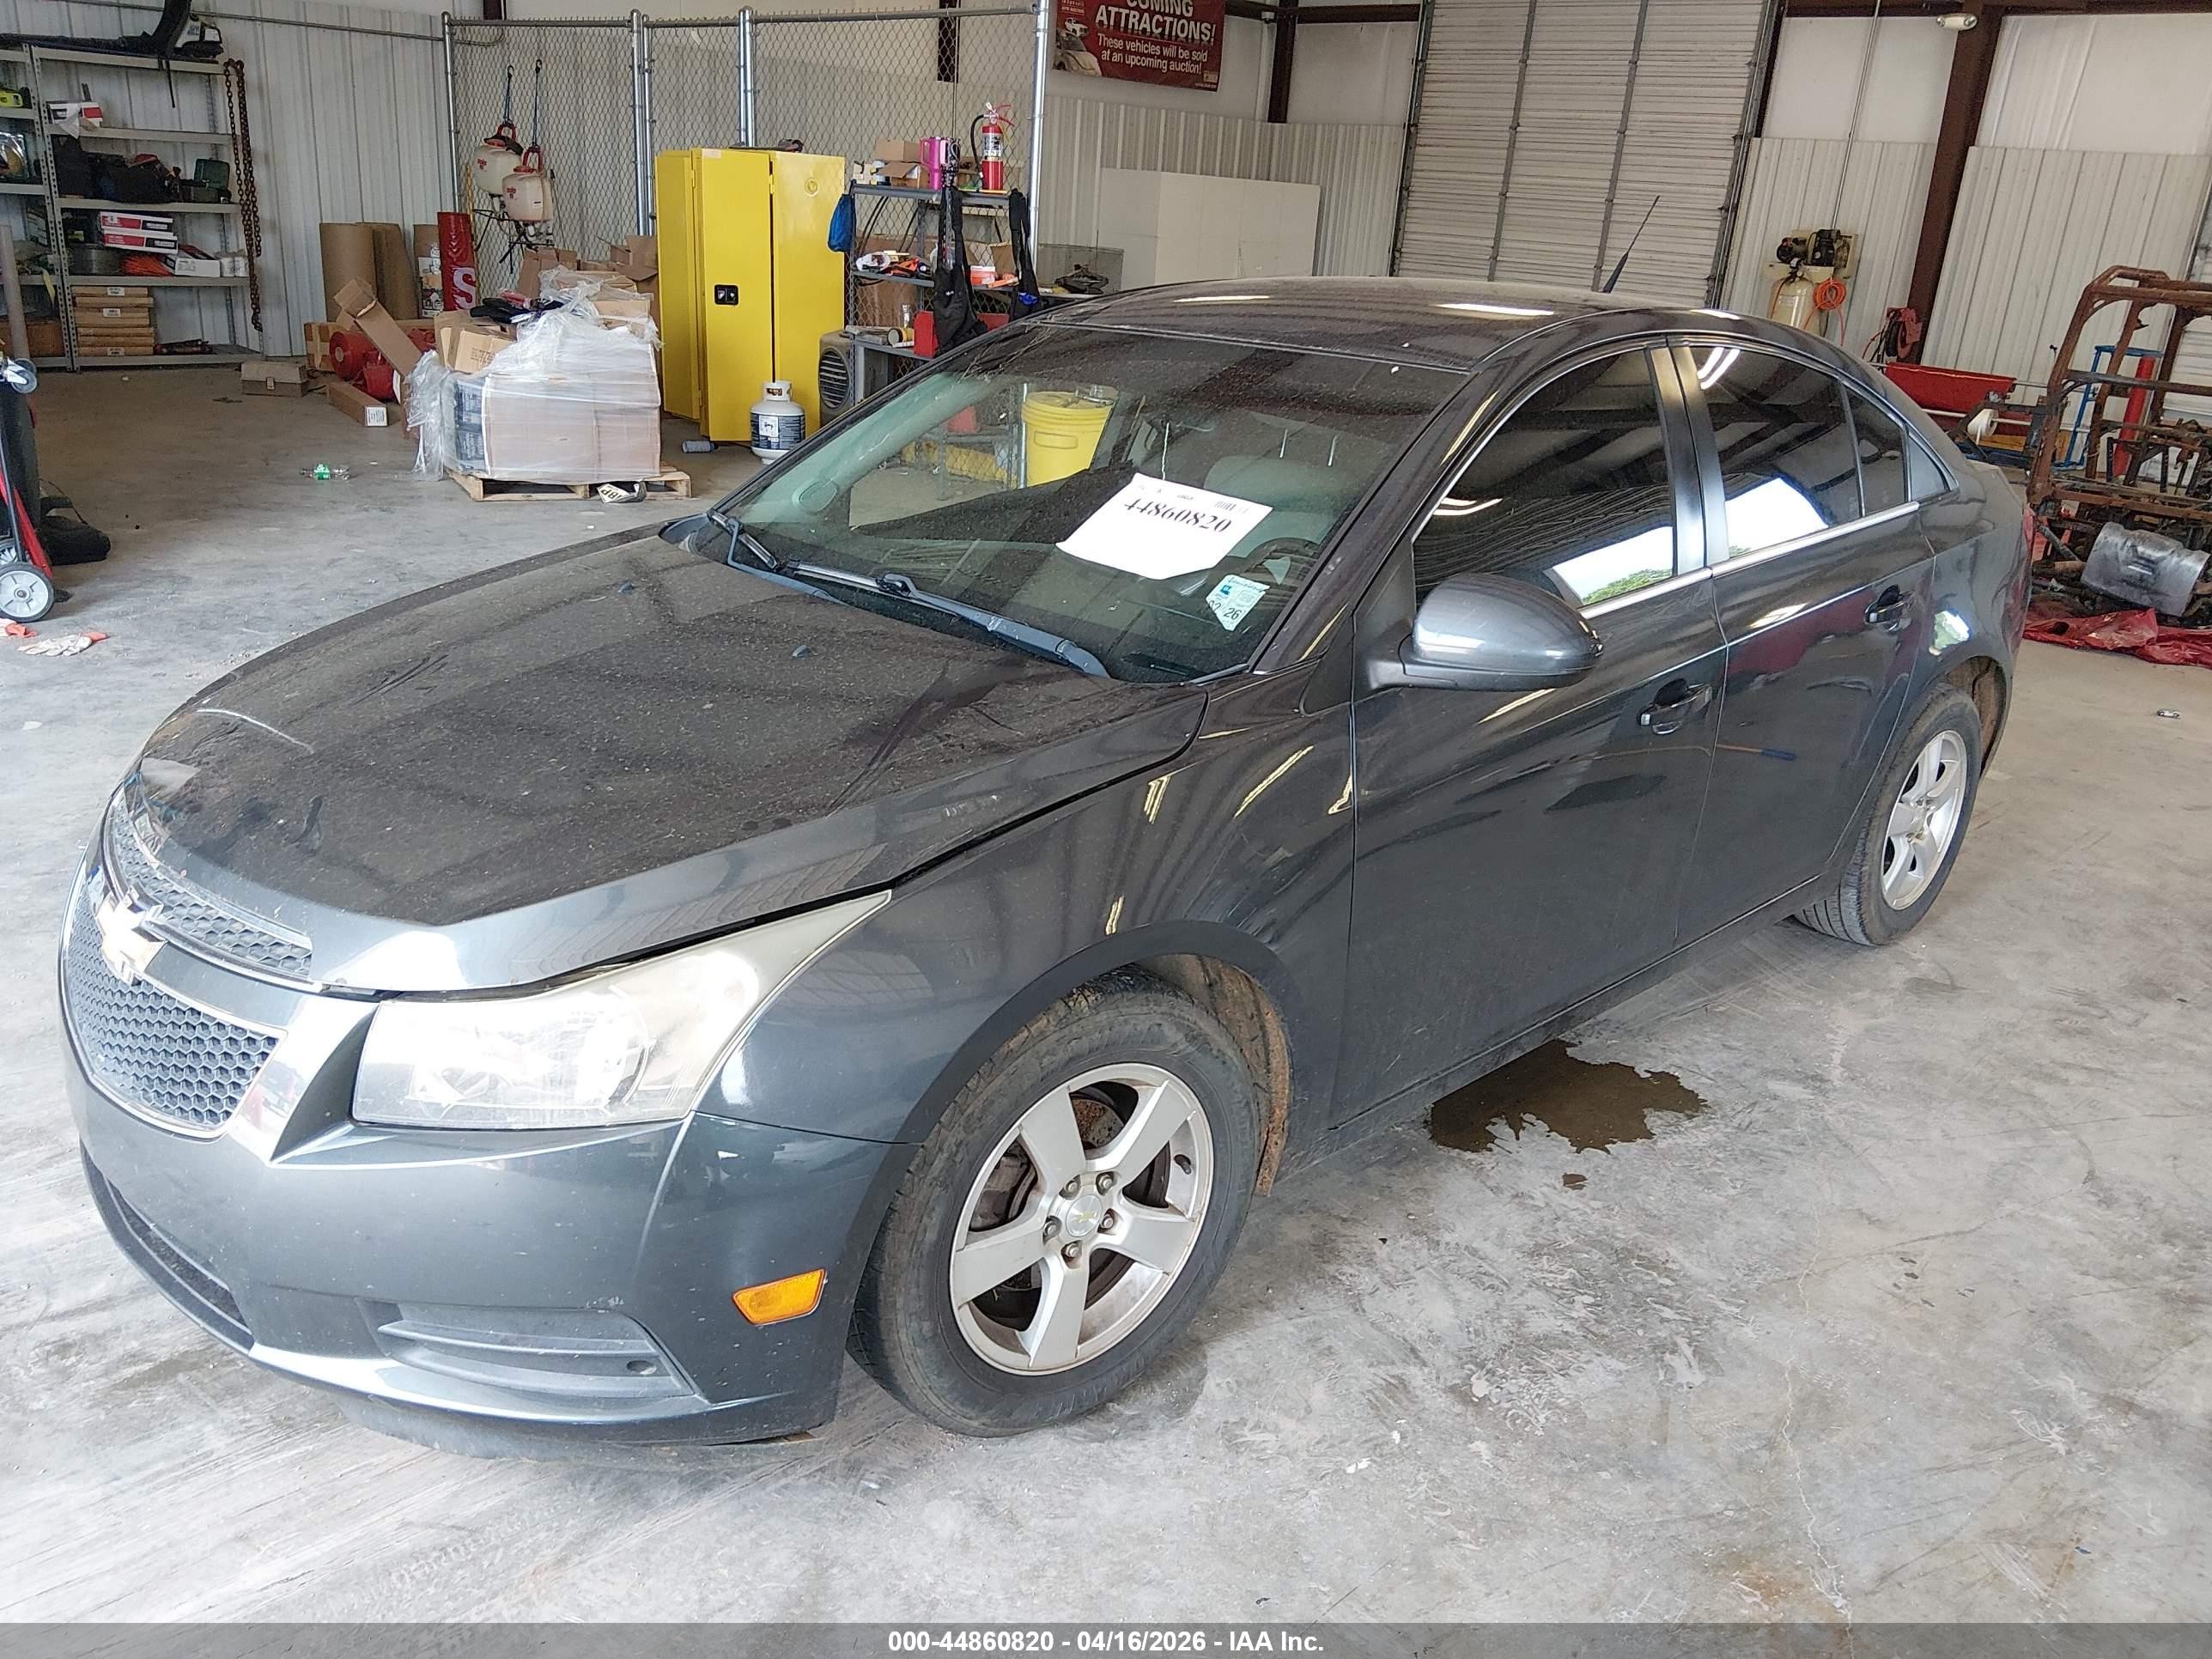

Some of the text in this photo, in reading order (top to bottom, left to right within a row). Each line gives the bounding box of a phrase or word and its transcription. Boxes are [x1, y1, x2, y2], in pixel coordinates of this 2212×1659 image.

[1095, 4, 1217, 42] ATTRACTIONS!
[1097, 33, 1208, 63] These vehicles will be sold
[1101, 49, 1202, 75] at an upcoming auction!
[1124, 498, 1232, 532] 44860820
[1223, 607, 1243, 620] 26
